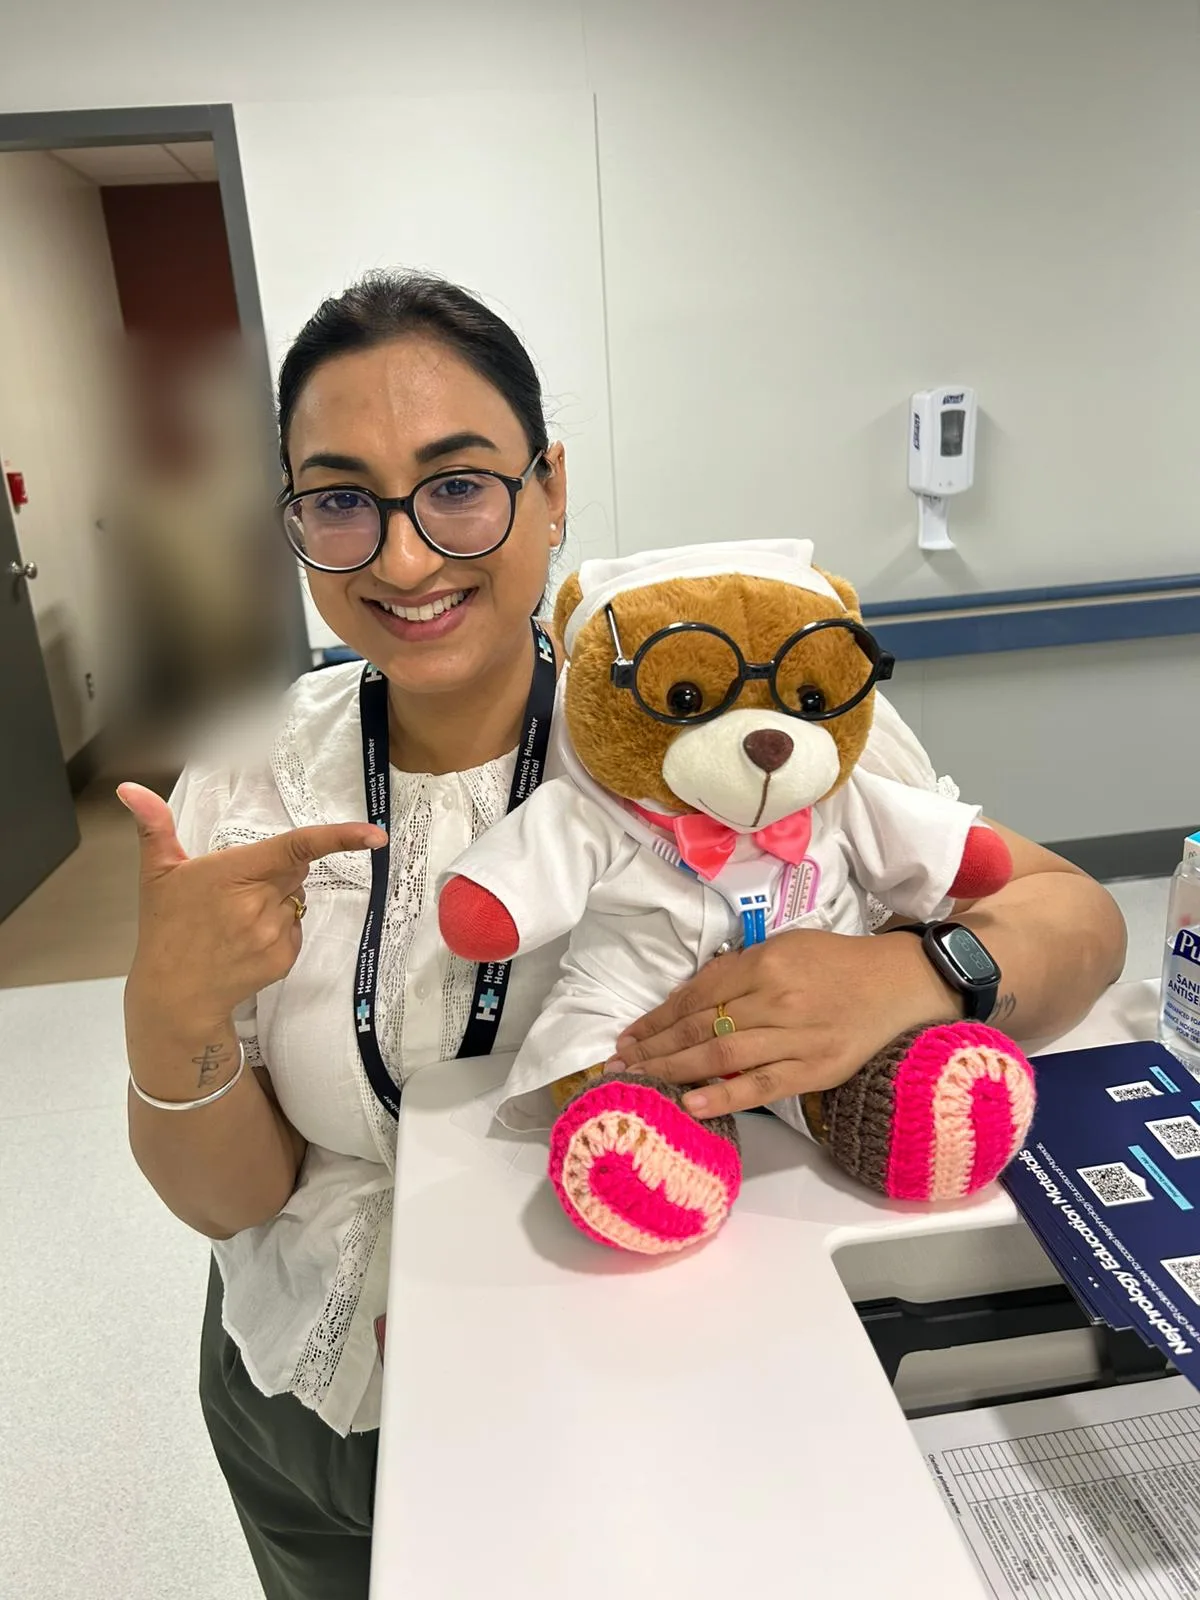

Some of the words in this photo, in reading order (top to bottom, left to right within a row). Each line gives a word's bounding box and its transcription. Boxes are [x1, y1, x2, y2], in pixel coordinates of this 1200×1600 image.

[368, 737, 376, 775] Humber
[516, 758, 530, 799] Hennick
[523, 717, 539, 757] Humber
[367, 776, 378, 816] Hennick
[377, 772, 386, 814] Hospital
[525, 759, 540, 800] ospital
[357, 950, 368, 995] Hennick
[363, 910, 375, 950] Humber
[364, 948, 375, 993] Hospital
[1019, 1149, 1068, 1205] Materials
[1051, 1167, 1085, 1202] Educational
[1061, 1204, 1121, 1270] Education
[1080, 1201, 1117, 1239] Nephrology
[1112, 1270, 1194, 1355] Nephrology
[1171, 1311, 1189, 1325] QR
